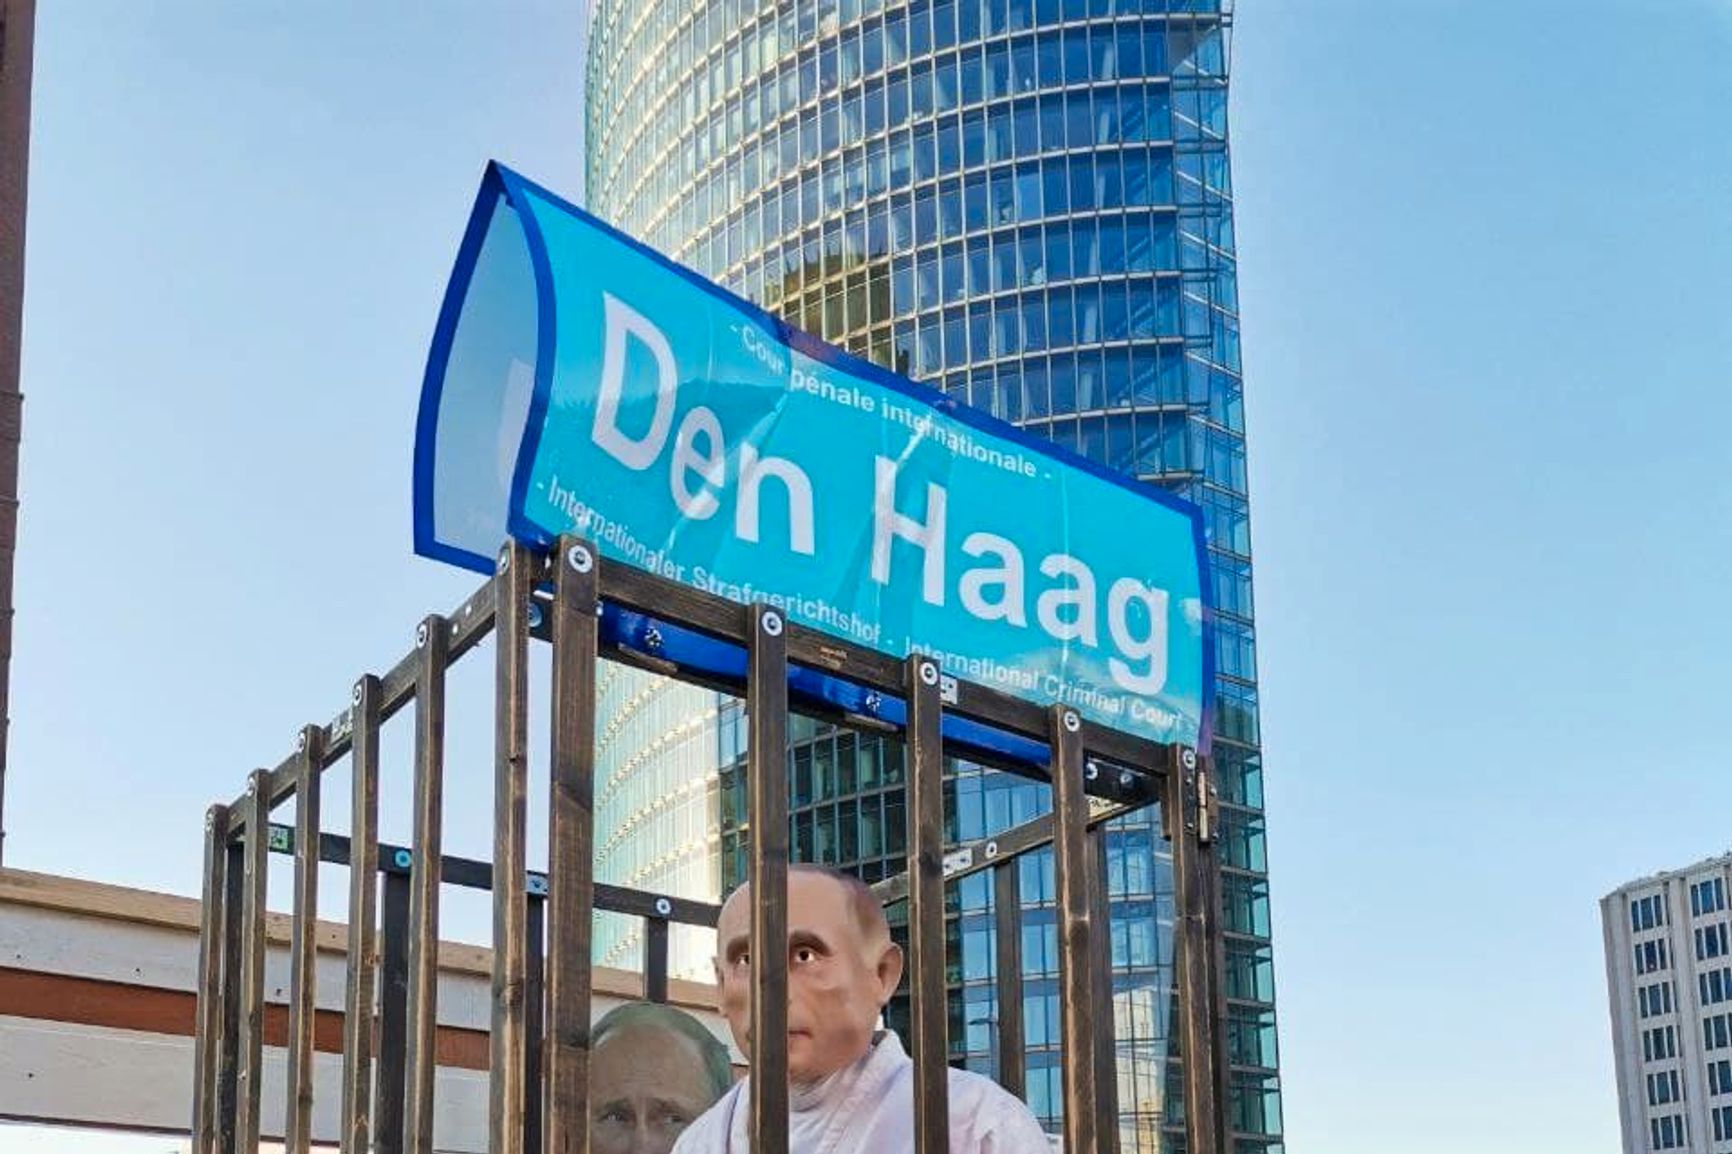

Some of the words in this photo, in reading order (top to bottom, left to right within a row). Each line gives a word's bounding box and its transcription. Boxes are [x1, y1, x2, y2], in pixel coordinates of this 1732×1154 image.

[591, 289, 816, 556] Den
[870, 454, 1170, 697] Haag
[742, 325, 786, 375] Cour
[790, 367, 875, 412] pénale
[881, 397, 1037, 478] internationale
[548, 474, 687, 583] Internationaler
[1043, 672, 1126, 715] Criminal
